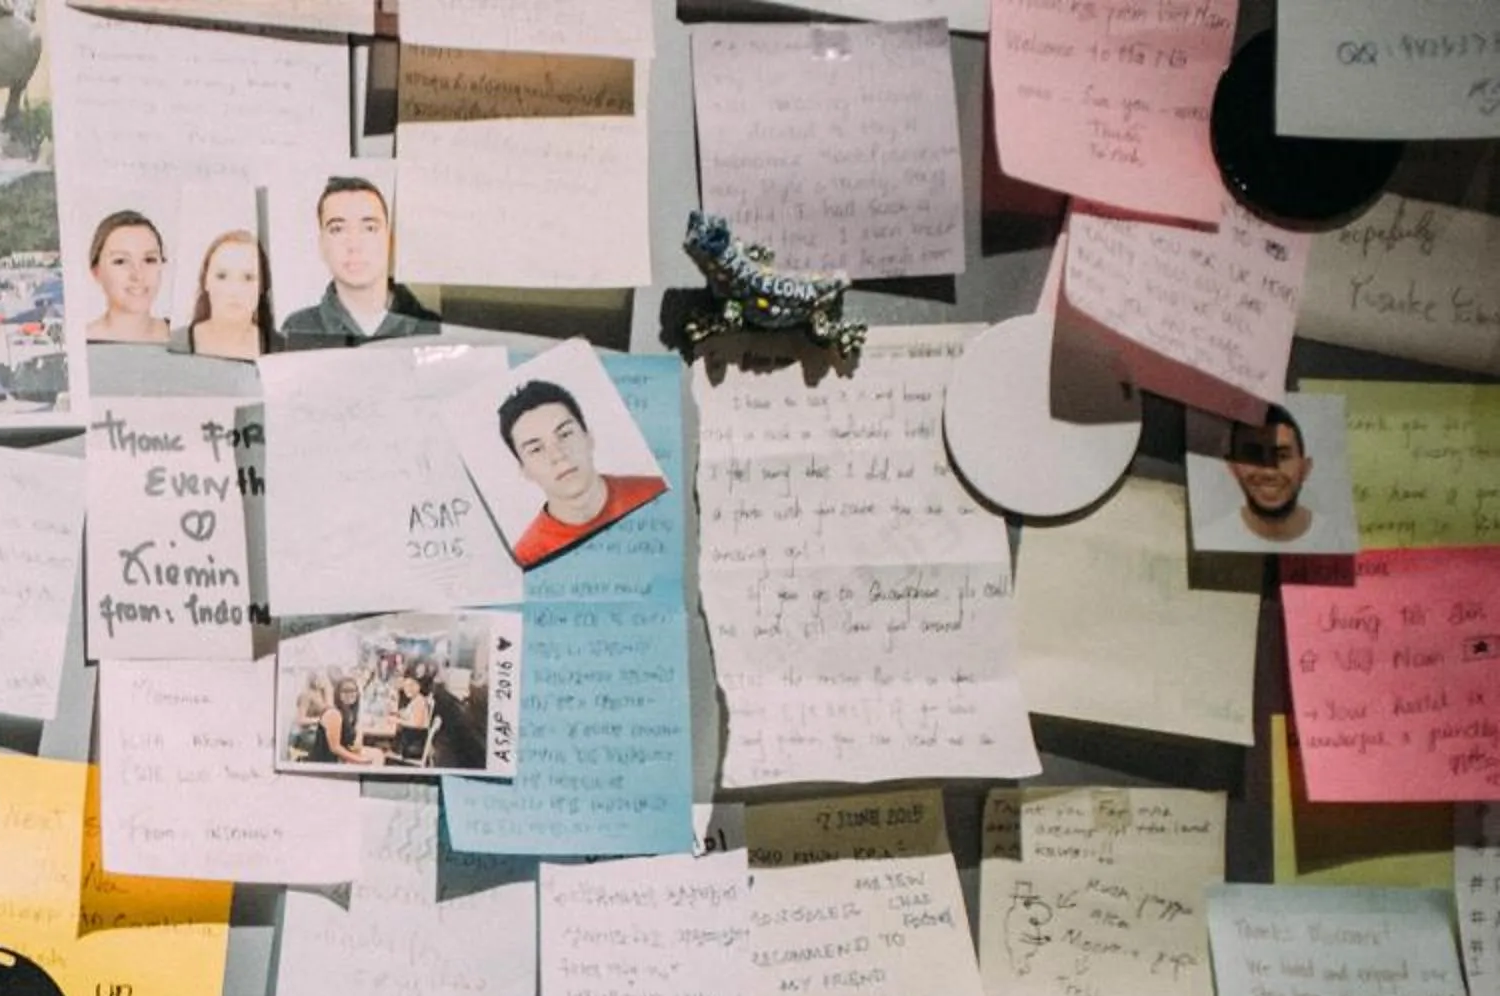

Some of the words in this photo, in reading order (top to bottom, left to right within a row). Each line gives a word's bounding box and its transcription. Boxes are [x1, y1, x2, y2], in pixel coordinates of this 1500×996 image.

[408, 499, 474, 533] ASAP
[496, 656, 515, 703] 2016
[493, 714, 514, 764] ASAP
